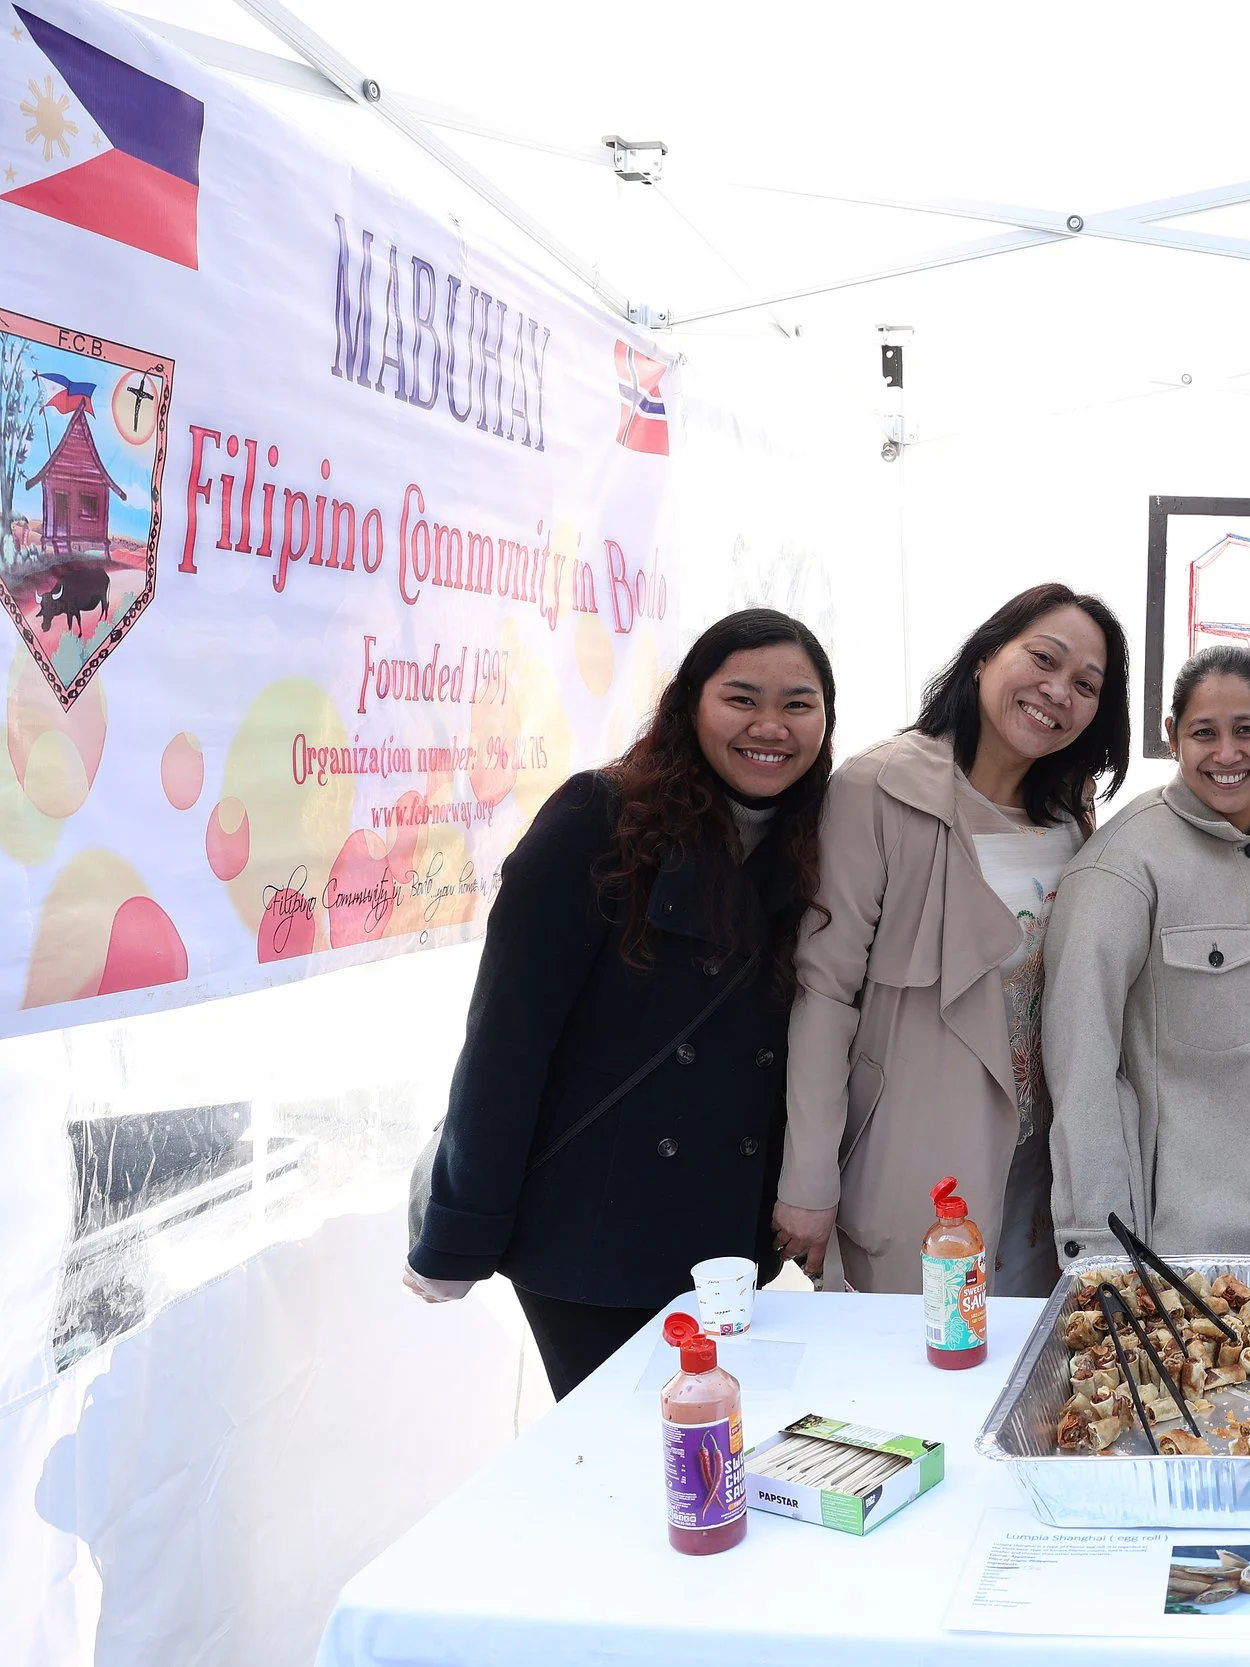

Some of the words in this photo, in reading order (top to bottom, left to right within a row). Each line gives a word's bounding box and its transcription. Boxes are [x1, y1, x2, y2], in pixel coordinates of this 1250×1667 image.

[58, 329, 107, 359] F.C.B.
[331, 213, 551, 452] MABUHAY
[178, 424, 384, 594] Filipino
[399, 483, 567, 631] Community
[572, 531, 598, 614] in
[357, 636, 467, 714] Founded
[469, 647, 509, 706] 1997
[292, 733, 412, 787] Organization
[417, 735, 477, 774] number:
[263, 864, 317, 954] Filipino
[322, 867, 390, 933] Community
[759, 1490, 799, 1508] PAPSTAR
[1006, 1532, 1049, 1542] Lumpia
[1051, 1534, 1107, 1543] Shanghai
[1117, 1535, 1139, 1543] egg
[1142, 1534, 1161, 1542] roll
